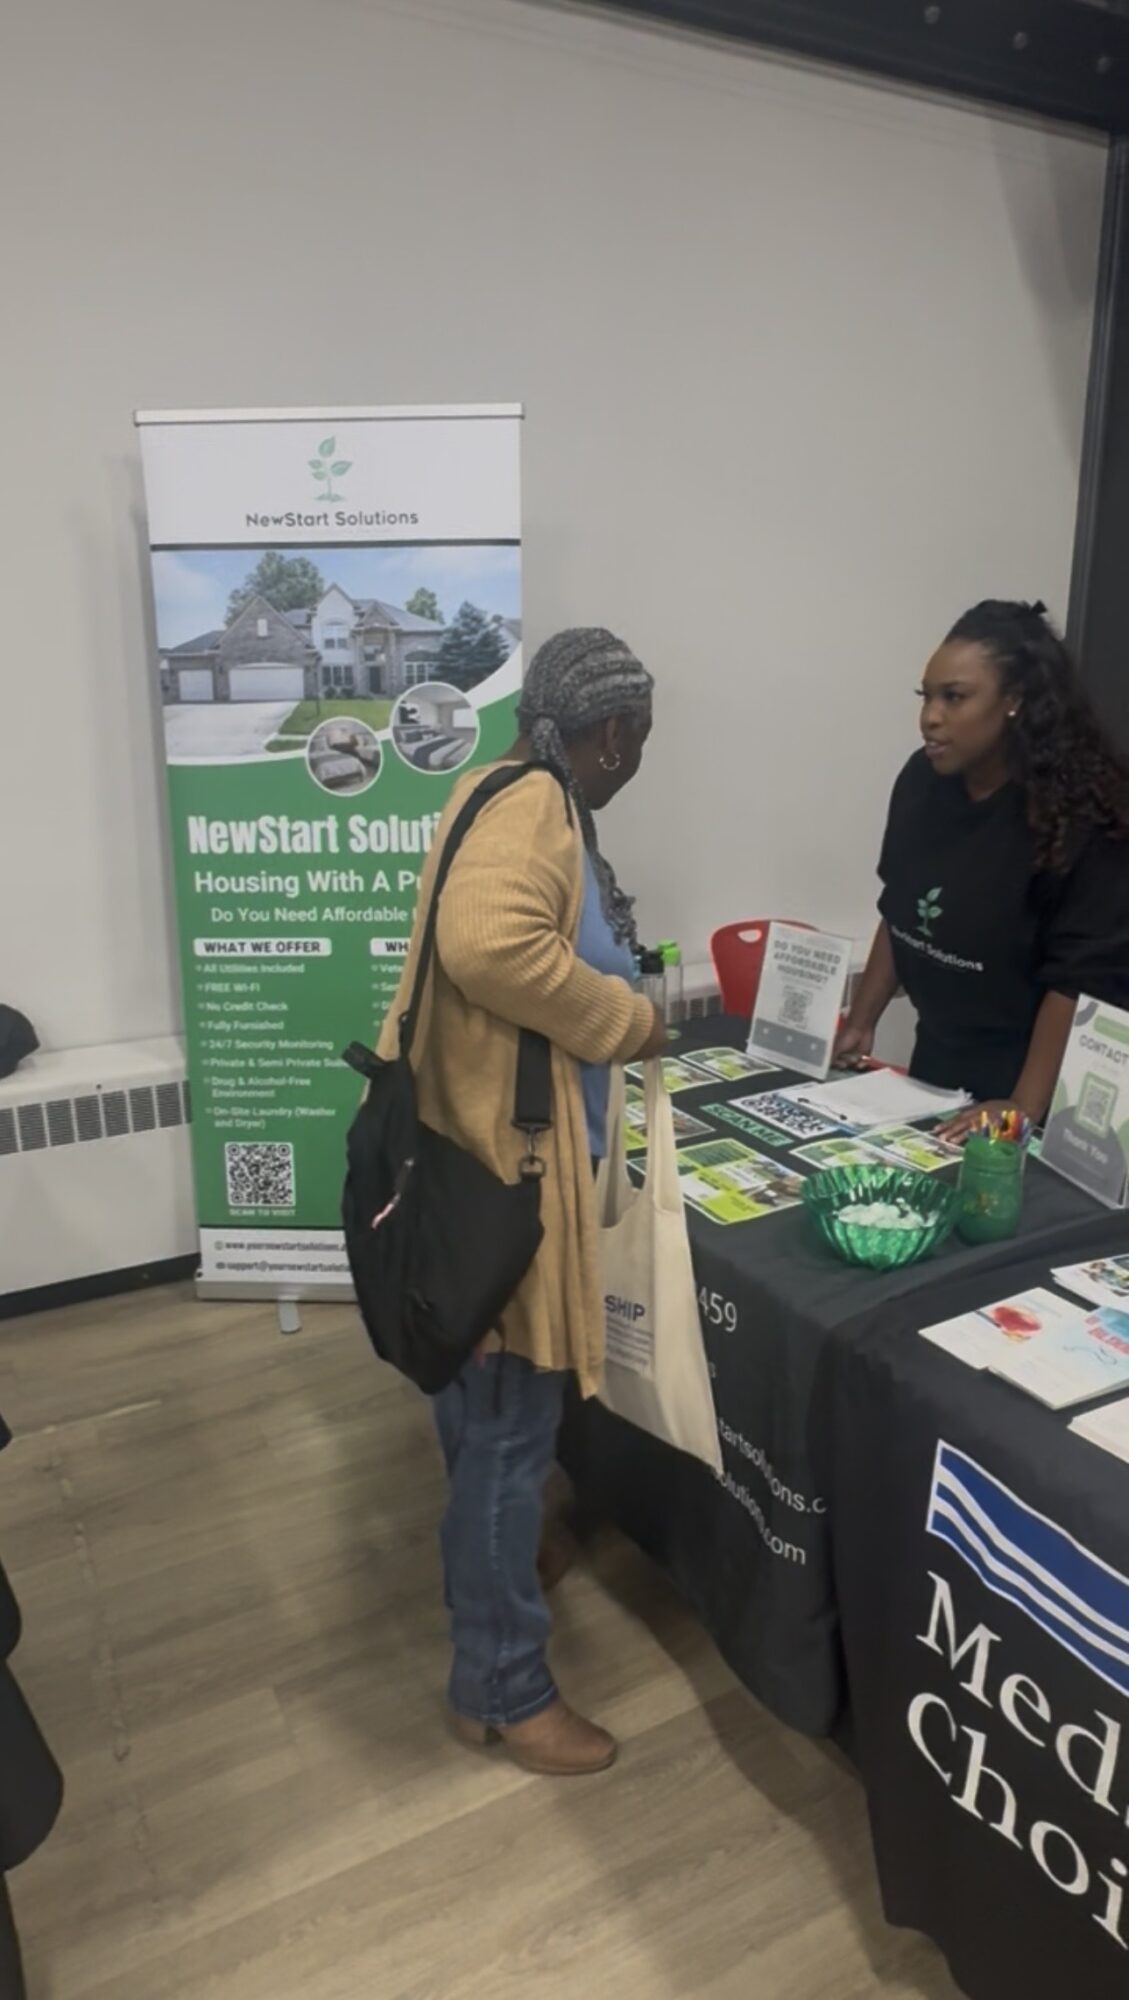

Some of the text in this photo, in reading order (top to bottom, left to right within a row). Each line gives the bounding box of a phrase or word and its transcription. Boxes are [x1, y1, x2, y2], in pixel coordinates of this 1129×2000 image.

[246, 511, 419, 527] NewStart Solutions
[188, 815, 339, 854] NewStart
[195, 871, 299, 898] Housing
[307, 870, 364, 892] With
[372, 871, 391, 892] A
[211, 907, 233, 922] Do
[238, 907, 270, 922] You
[274, 907, 318, 922] Need
[322, 906, 408, 922] Affordable
[204, 941, 321, 953] WHAT WE OFFER
[791, 943, 811, 957] YOU
[813, 949, 841, 965] NEED
[204, 963, 305, 973] All Utilities Included
[773, 952, 838, 976] AFFORDABLE
[205, 983, 230, 993] FREE
[206, 1001, 288, 1012] No Credit Check
[208, 1020, 284, 1032] Fully Furnished
[209, 1039, 334, 1051] 24/7 Security Monitoring
[1079, 1034, 1129, 1066] CONTACT
[210, 1058, 245, 1068] Private
[259, 1058, 283, 1068] Semi
[286, 1057, 321, 1068] Private
[211, 1076, 236, 1087] Drug
[248, 1076, 311, 1086] Alcohol-Free
[212, 1089, 275, 1098] Environment
[252, 1106, 292, 1118] Laundry
[215, 1118, 233, 1128] and
[604, 1294, 646, 1322] SHIP
[916, 1570, 1129, 1829] Med
[907, 1691, 1129, 1950] Choi
